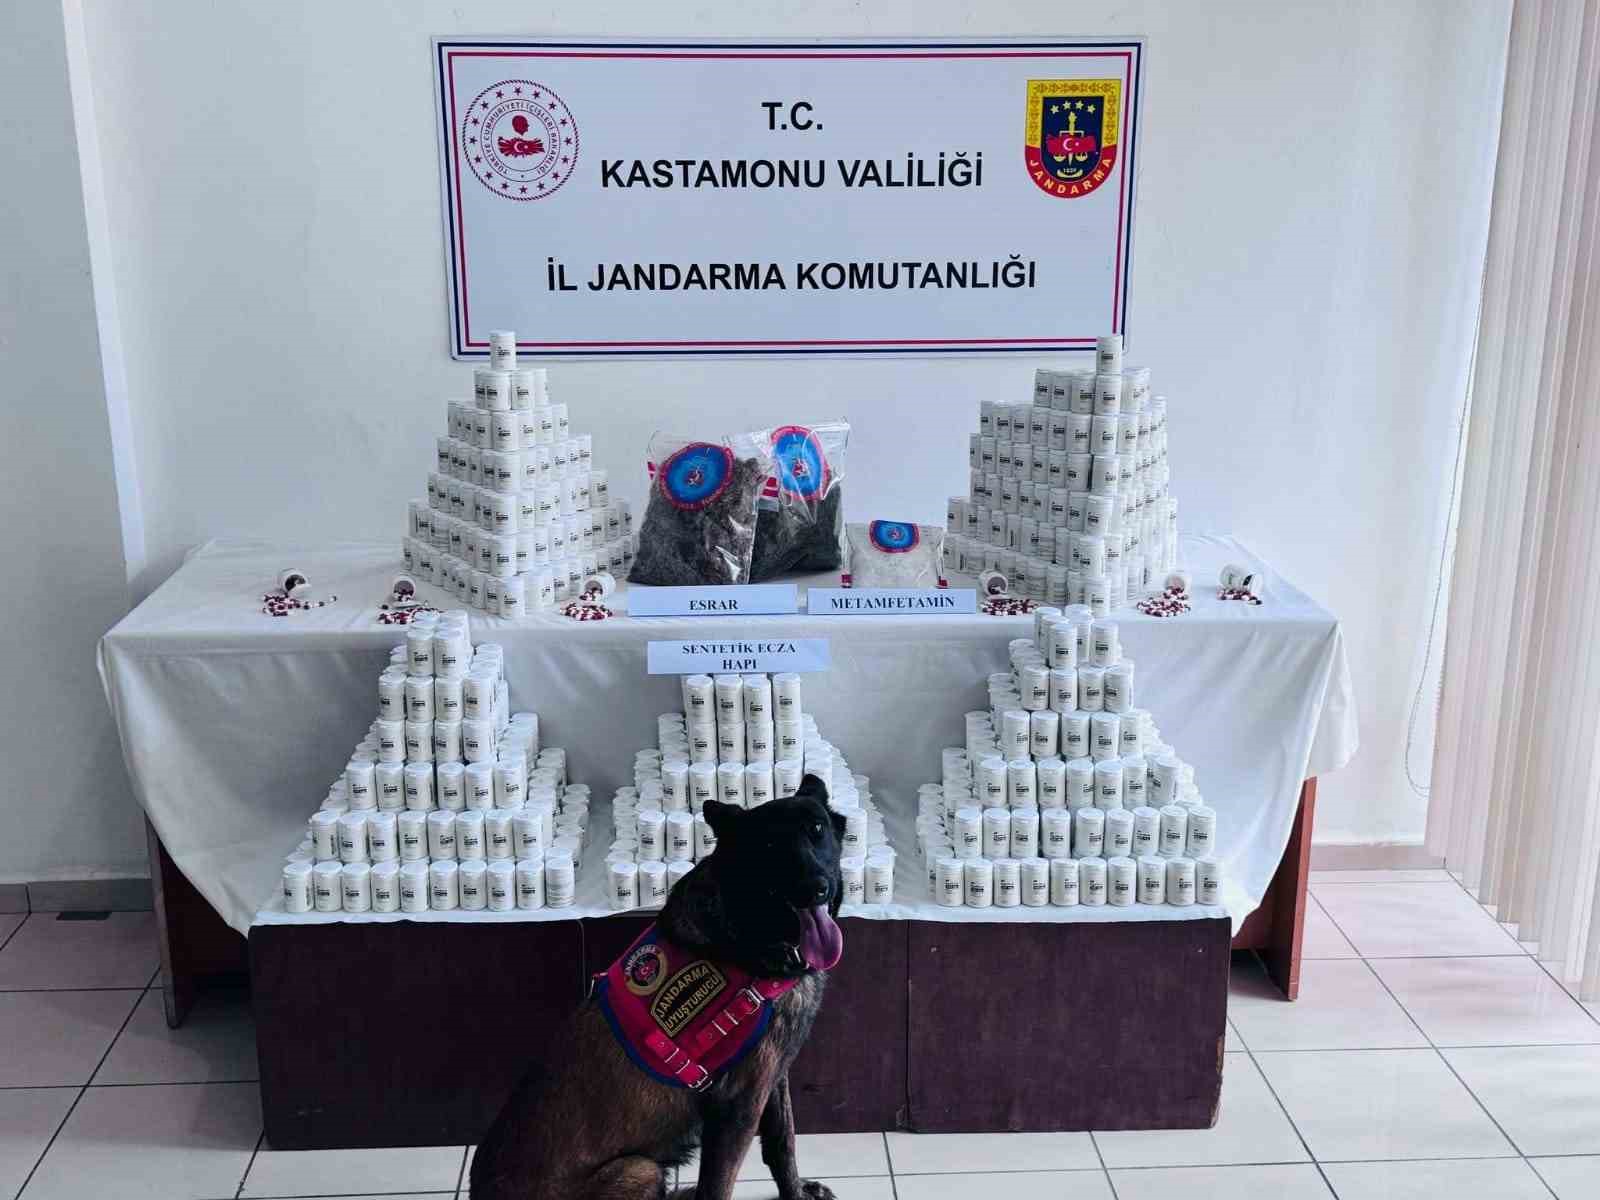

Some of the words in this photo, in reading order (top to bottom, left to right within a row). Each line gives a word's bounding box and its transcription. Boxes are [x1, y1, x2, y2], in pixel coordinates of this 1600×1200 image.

[762, 101, 823, 131] T.C.
[601, 159, 825, 189] KASTAMONU
[837, 151, 982, 188] VALİLİĞİ
[1029, 158, 1112, 195] JANDARMA
[547, 256, 578, 291] İL
[587, 263, 787, 292] JANDARMA
[797, 254, 1036, 290] KOMUTANLIĞI
[688, 598, 739, 611] ESRAR
[831, 594, 956, 610] METAMFETAMİN
[682, 641, 753, 655] SENTETİK
[757, 642, 797, 654] ECZA
[722, 658, 758, 671] HAPI
[656, 965, 710, 1018] JANDARMA
